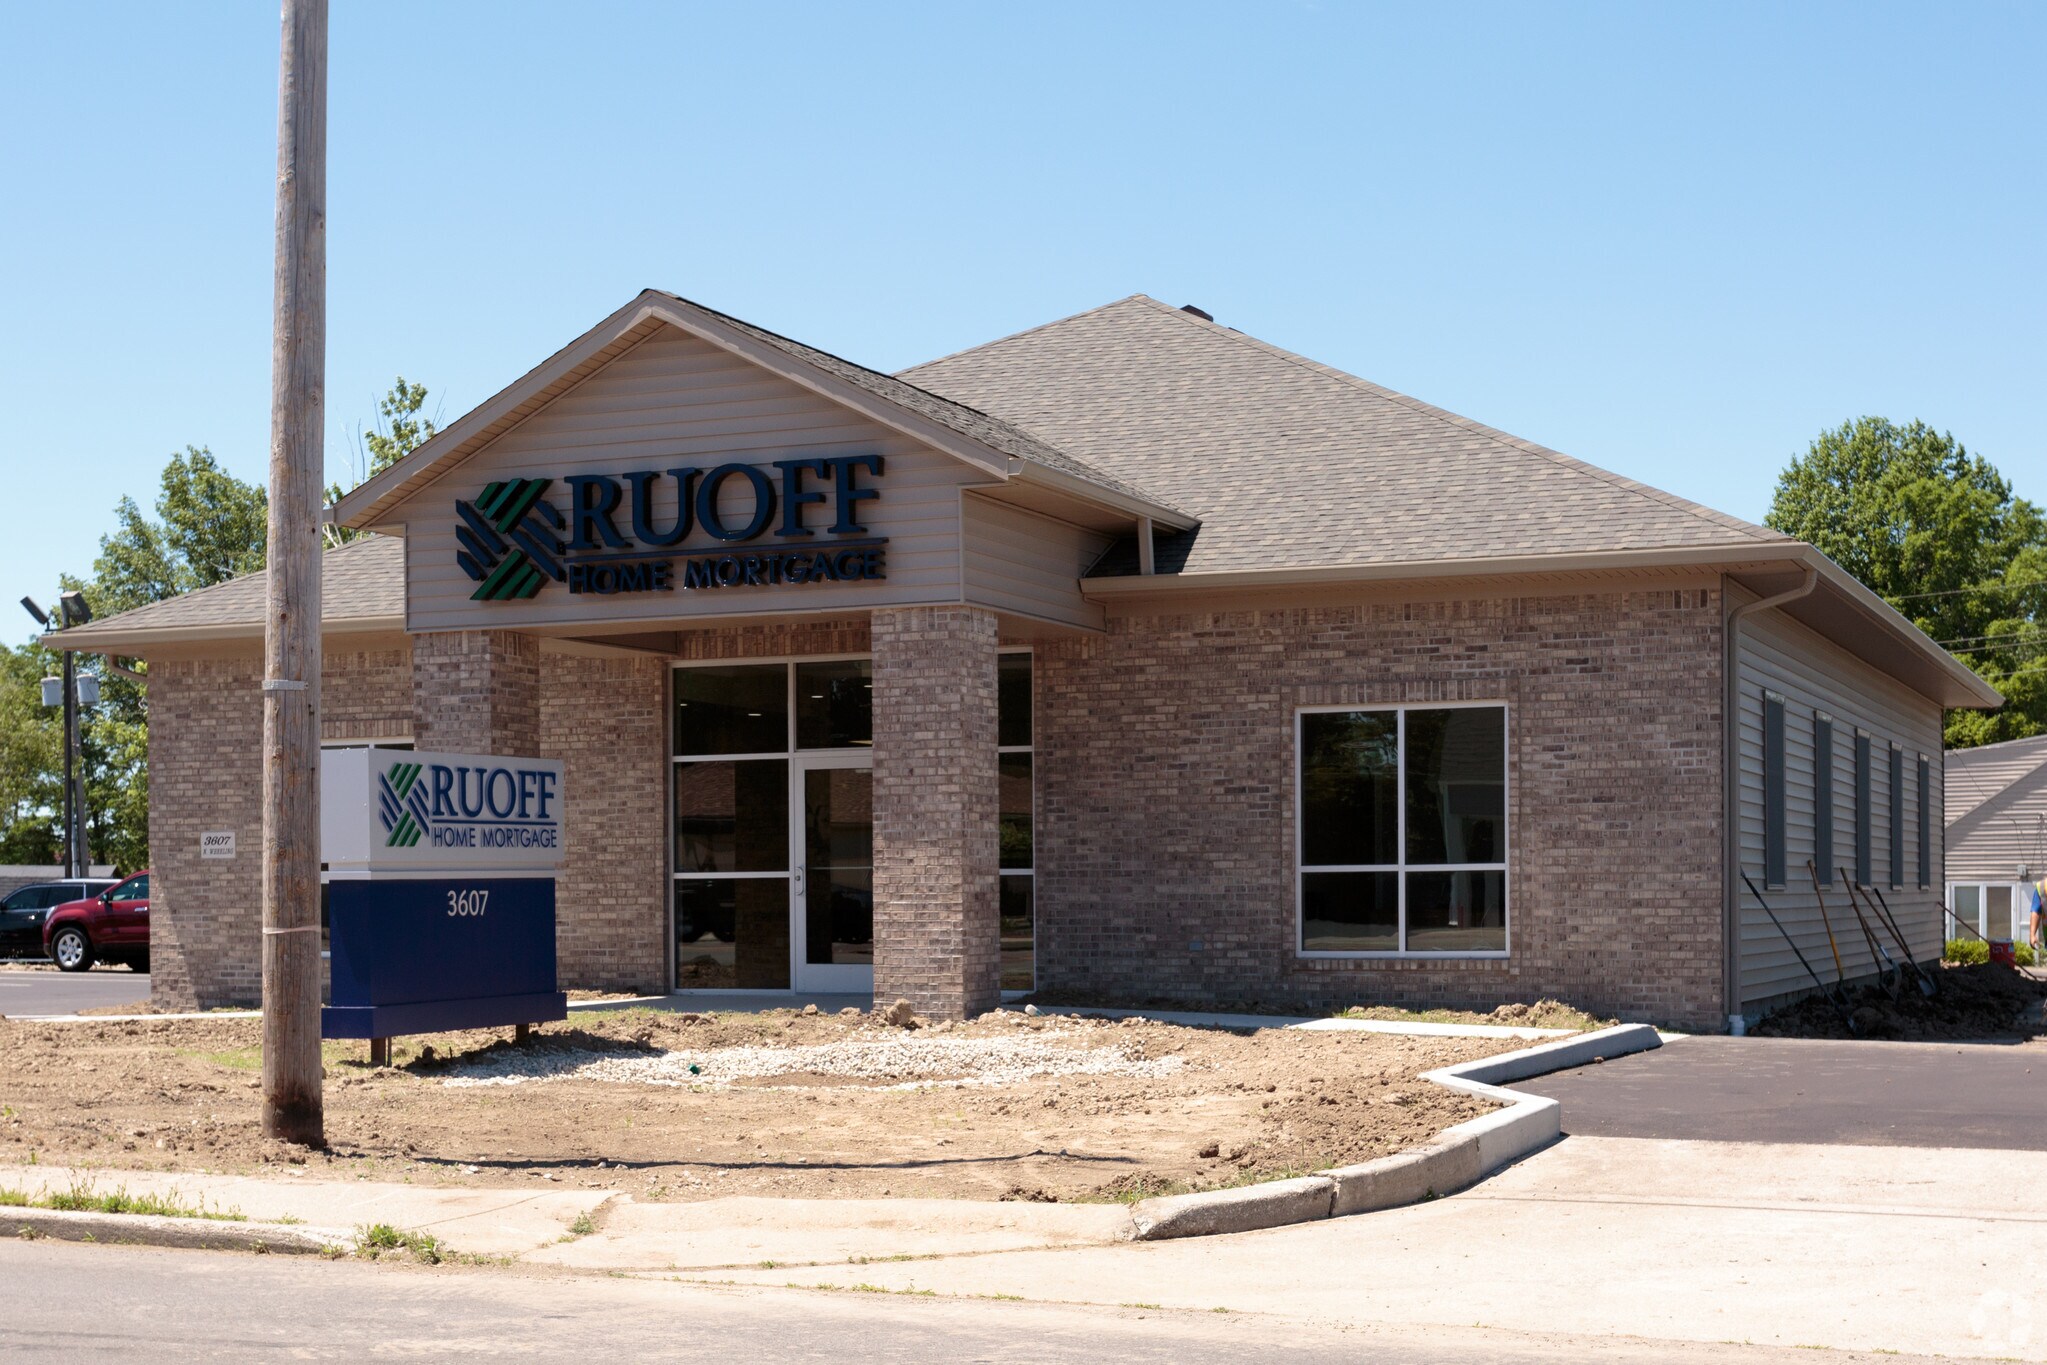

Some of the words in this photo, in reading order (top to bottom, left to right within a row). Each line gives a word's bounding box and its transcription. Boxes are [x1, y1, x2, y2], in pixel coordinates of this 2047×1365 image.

[564, 455, 885, 550] RUOFF
[569, 560, 673, 594] HOME
[684, 550, 888, 588] MORTGAGE
[429, 765, 557, 818] RUOFF
[204, 835, 231, 846] 3607
[432, 827, 476, 848] HOME
[481, 828, 557, 848] MORTGAGE
[447, 889, 489, 917] 3607
